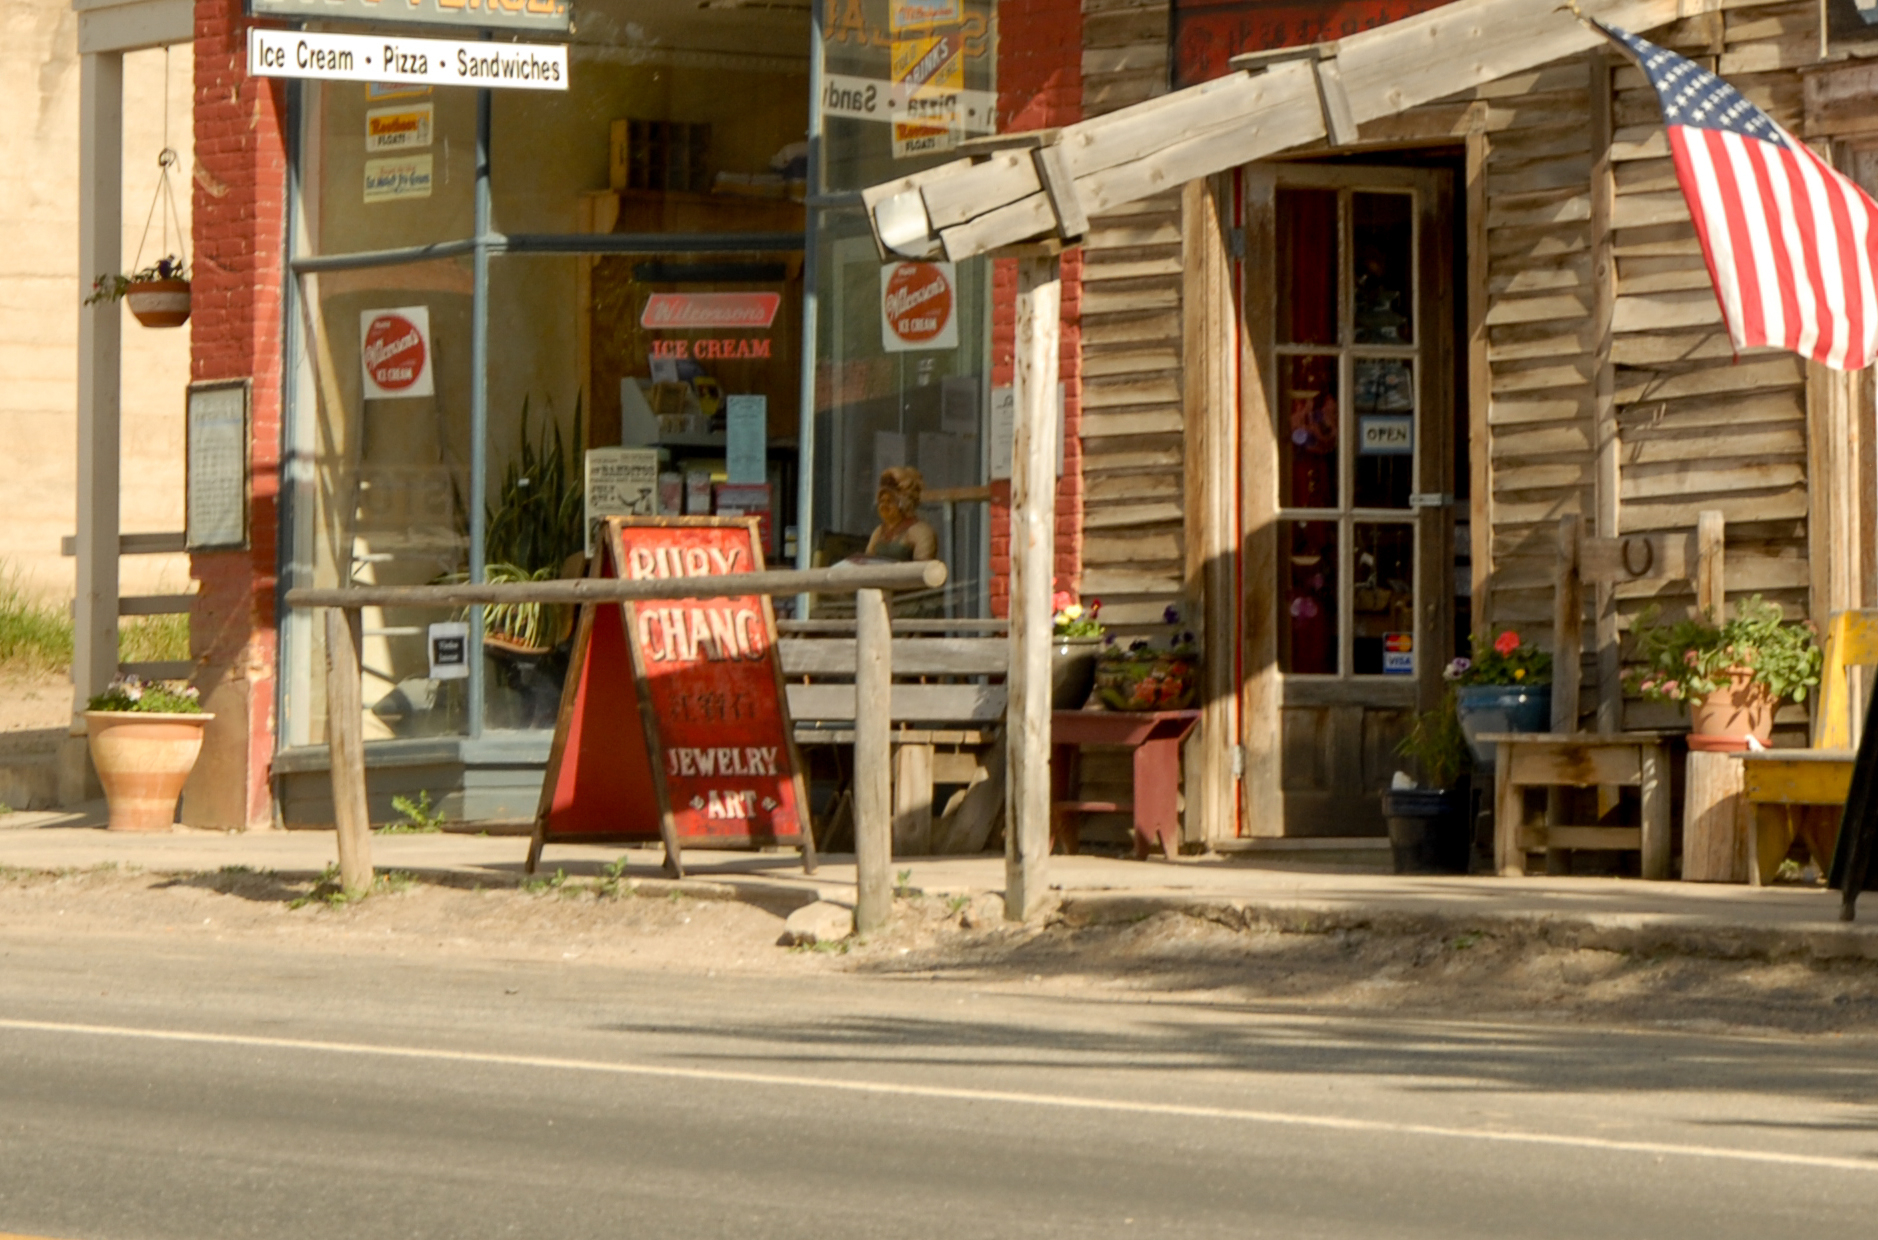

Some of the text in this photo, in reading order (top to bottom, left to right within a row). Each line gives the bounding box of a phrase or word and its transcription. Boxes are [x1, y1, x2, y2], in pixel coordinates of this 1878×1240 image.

[259, 38, 560, 81] Ice Cream Pizza Sandwiches
[898, 317, 937, 333] ICE CREAM
[651, 338, 772, 360] ICE CREAM
[388, 367, 413, 381] CREAM
[1366, 428, 1406, 441] OPEN
[668, 746, 777, 776] JEWELRY
[708, 790, 757, 819] ART
